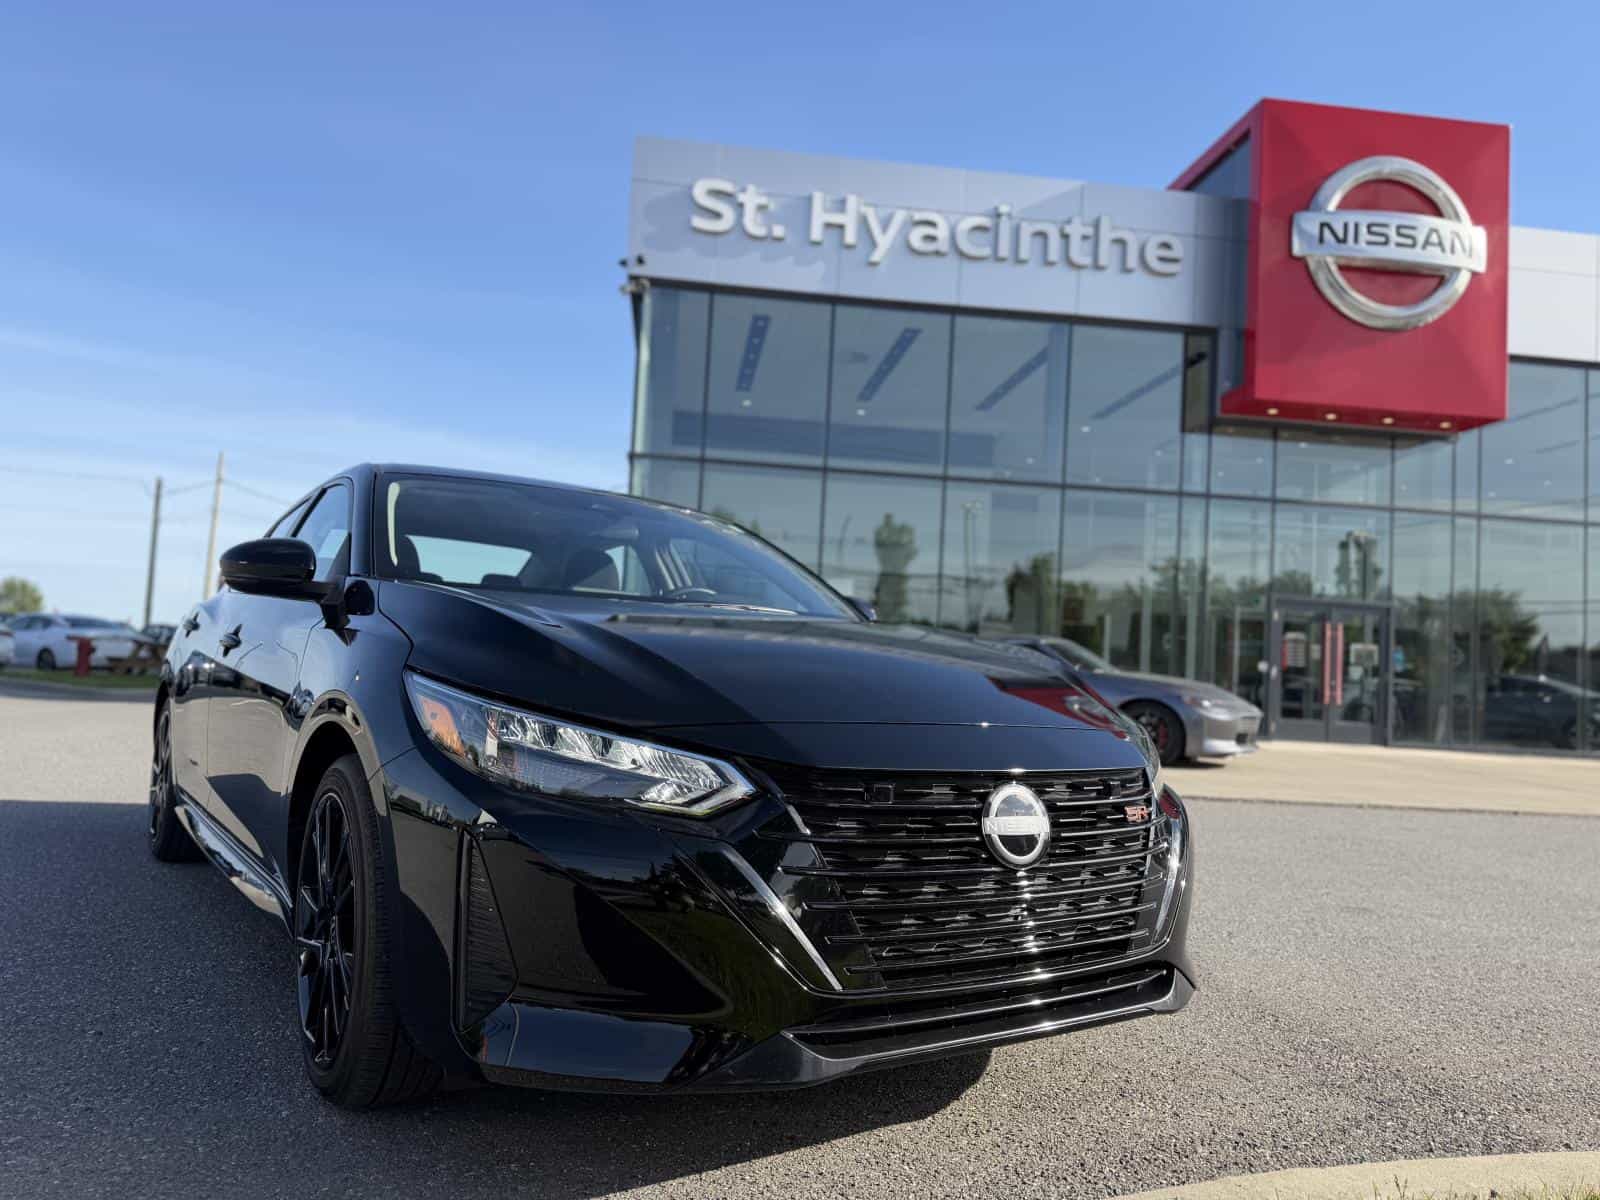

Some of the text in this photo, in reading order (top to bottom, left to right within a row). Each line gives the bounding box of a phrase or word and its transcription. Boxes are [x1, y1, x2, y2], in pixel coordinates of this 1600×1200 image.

[690, 178, 1184, 276] St. Hyacinthe
[1318, 221, 1473, 259] NISSAN
